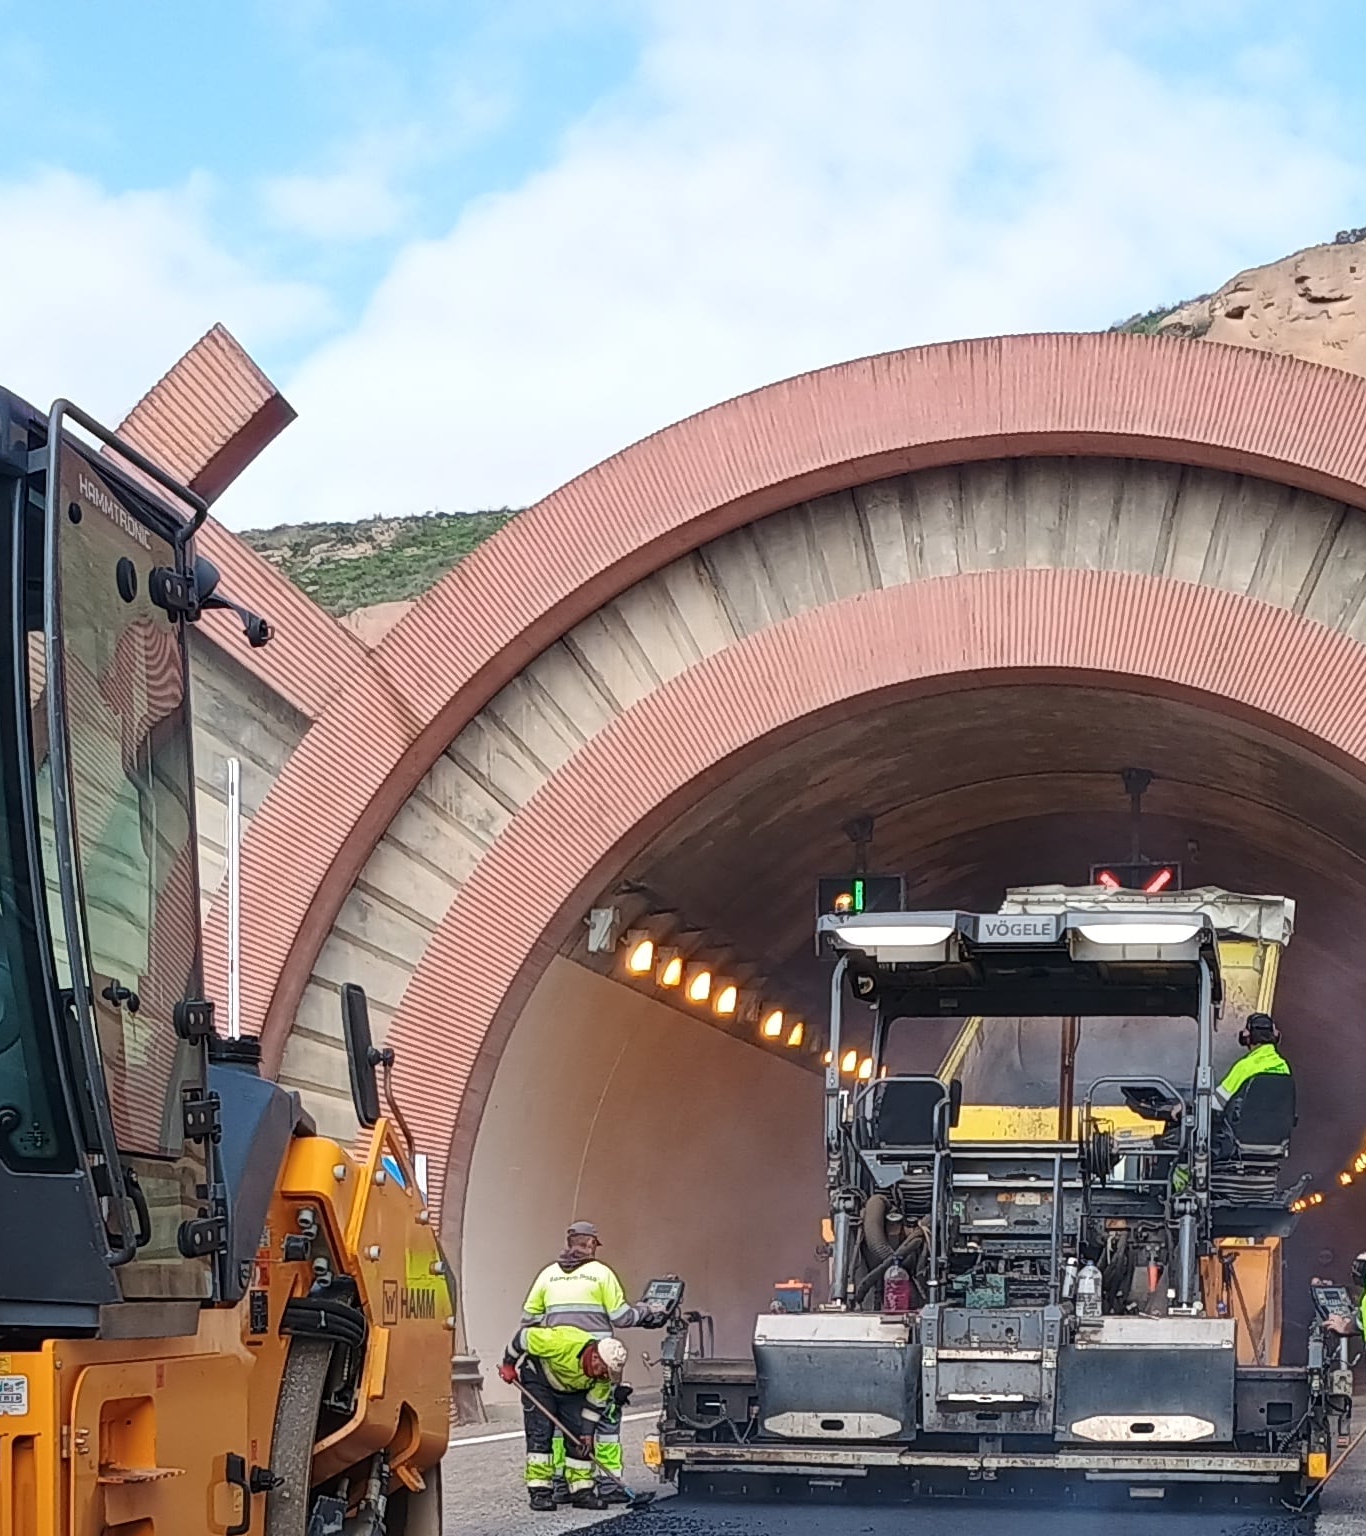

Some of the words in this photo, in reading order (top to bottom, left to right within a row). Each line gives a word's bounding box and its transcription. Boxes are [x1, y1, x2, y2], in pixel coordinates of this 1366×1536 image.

[78, 472, 152, 551] HAMMTRONIC
[985, 919, 1052, 937] VÖGELE
[400, 1287, 436, 1319] HAMM
